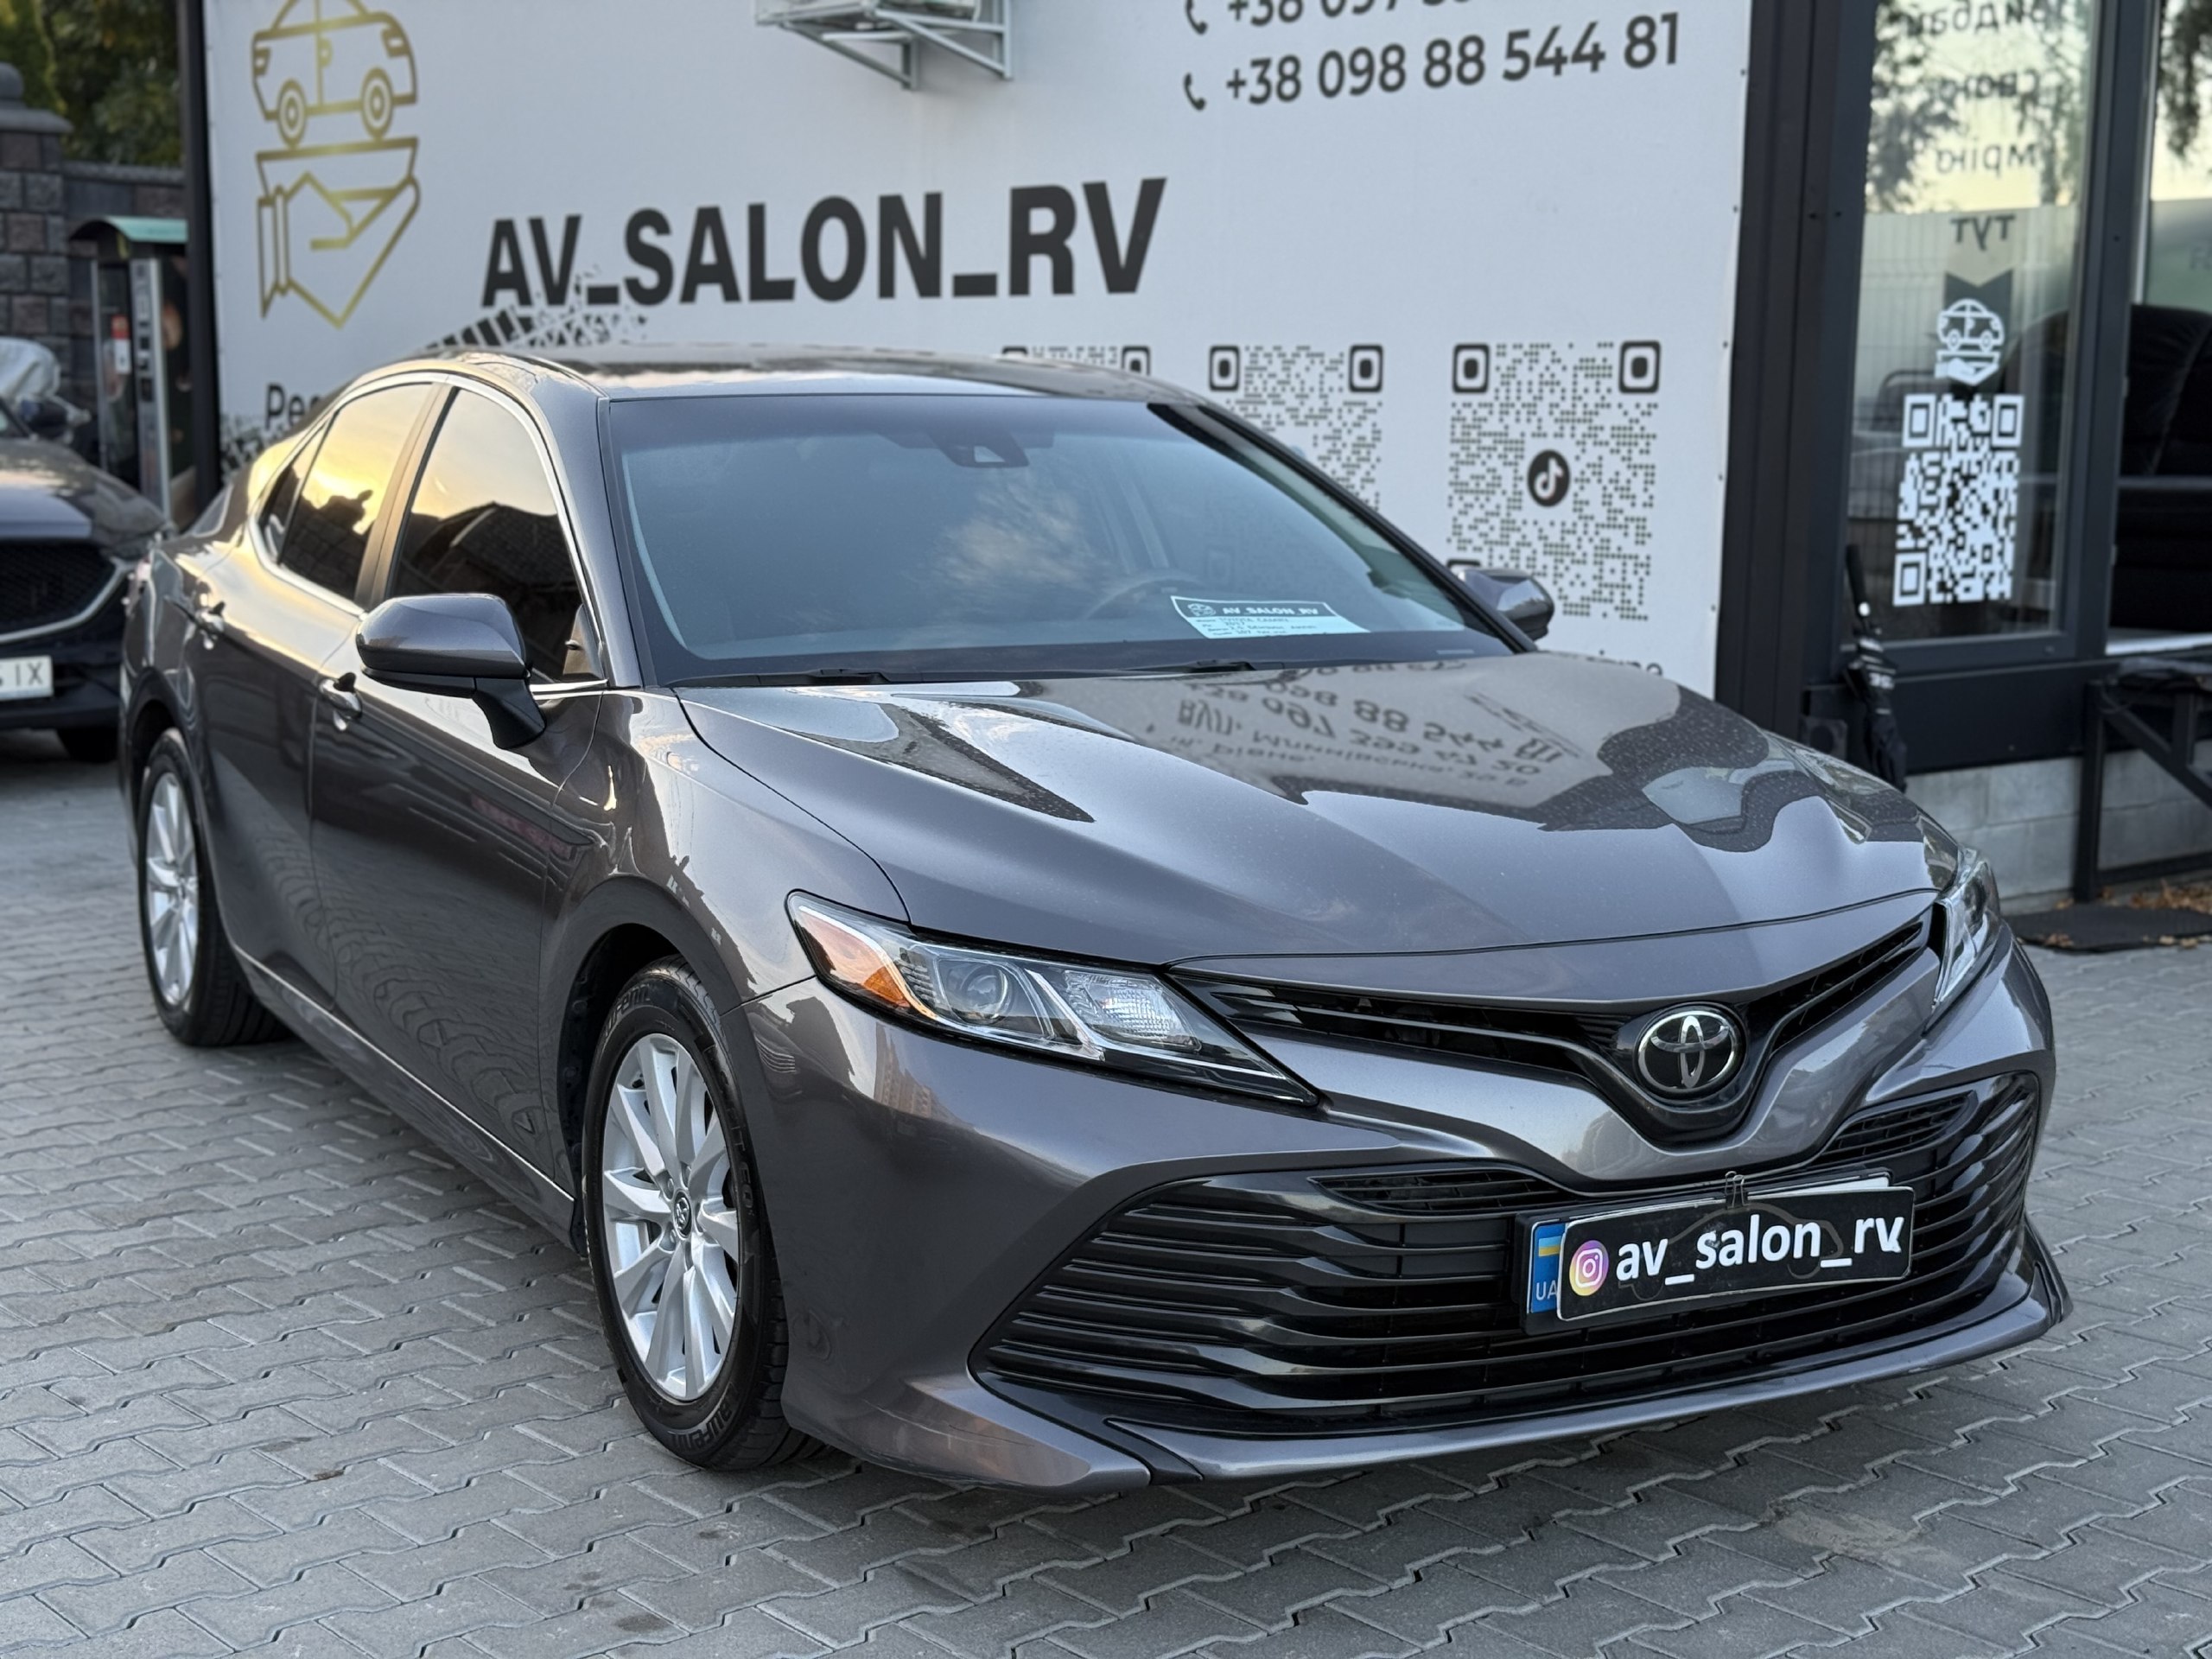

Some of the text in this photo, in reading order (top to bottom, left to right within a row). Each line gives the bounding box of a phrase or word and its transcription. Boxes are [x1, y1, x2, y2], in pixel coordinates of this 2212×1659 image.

[1226, 13, 1678, 105] +38 098 88 544 81
[480, 178, 1167, 308] AV_SALON_RV
[15, 662, 43, 687] IX
[1617, 1213, 1904, 1286] av_salon_rv
[1535, 1279, 1557, 1301] UA
